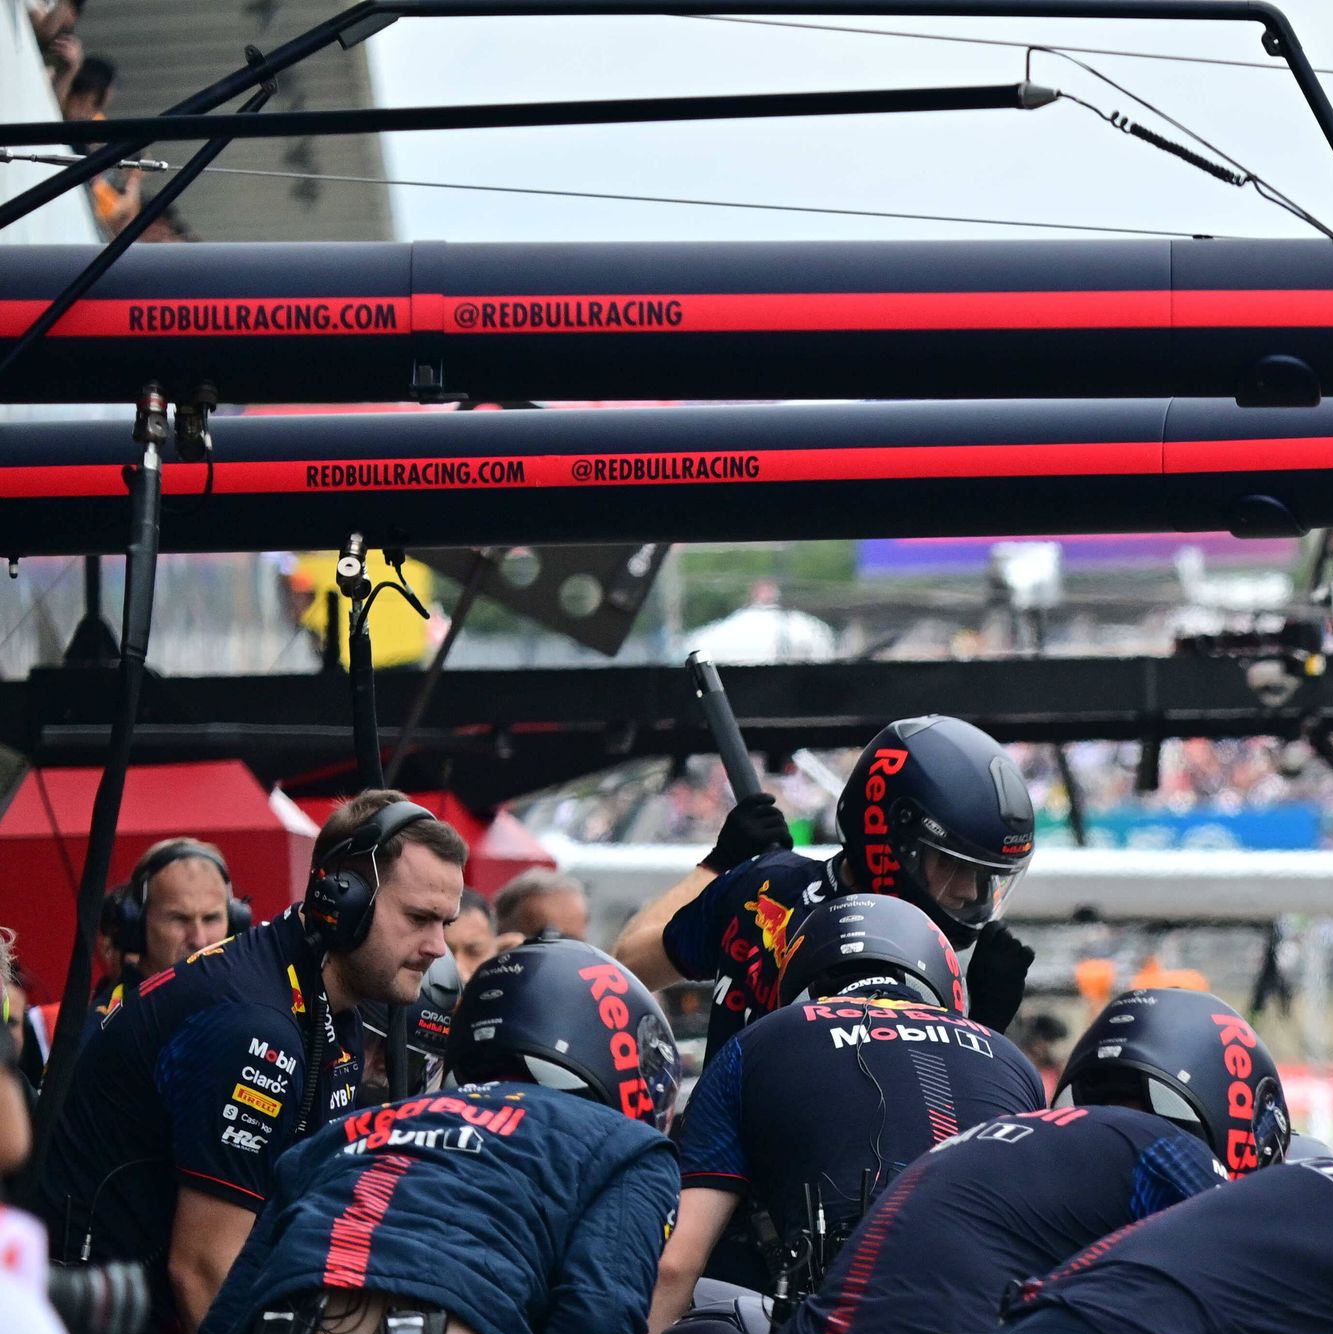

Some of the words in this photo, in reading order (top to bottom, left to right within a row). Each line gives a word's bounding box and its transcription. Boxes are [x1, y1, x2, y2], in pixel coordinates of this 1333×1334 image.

[129, 304, 397, 331] REDBULLRACING.COM
[454, 301, 682, 329] @REDBULLRACING
[306, 460, 526, 488] REDBULLRACING.COM
[571, 456, 760, 481] @REDBULLRACING
[863, 748, 908, 835] Red
[865, 844, 900, 898] Bu
[829, 899, 876, 912] Therabody
[421, 1010, 452, 1025] ORAC
[578, 963, 641, 1072] Red
[803, 1004, 890, 1022] Red
[906, 1009, 992, 1038] Bull
[830, 1024, 949, 1049] Mobil
[248, 1038, 297, 1075] Mobil
[1211, 1014, 1257, 1121] Red
[241, 1066, 285, 1094] Claro
[237, 1087, 278, 1113] PIRELLI
[344, 1098, 428, 1142] Red
[427, 1096, 525, 1136] Bull
[222, 1126, 268, 1150] HRC
